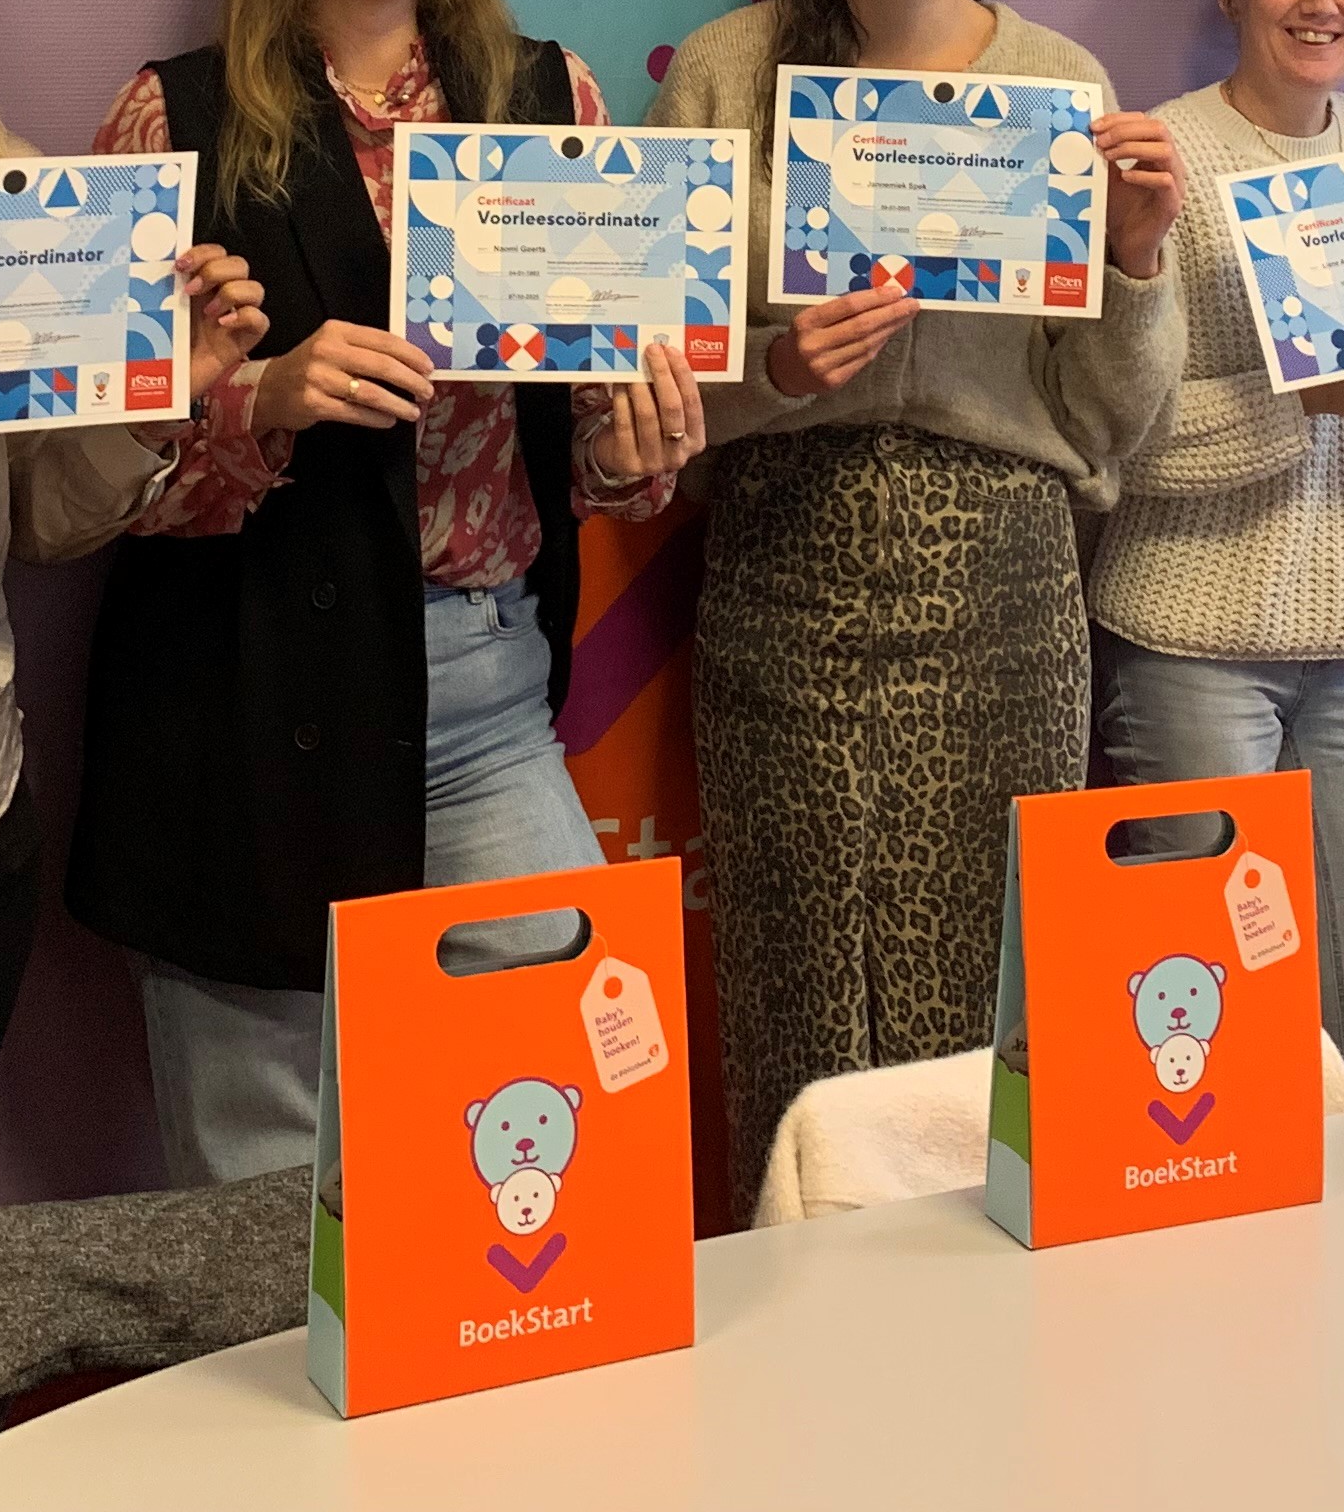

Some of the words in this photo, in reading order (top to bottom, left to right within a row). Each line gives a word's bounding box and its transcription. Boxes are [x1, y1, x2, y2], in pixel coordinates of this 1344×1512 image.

[853, 134, 908, 147] Certificaat
[853, 147, 1025, 170] Voorleescoördinator
[477, 195, 536, 207] Certificaat
[477, 210, 660, 229] Voorleescoördinator
[1297, 216, 1344, 233] Certificaat
[594, 1006, 624, 1026] Baby's
[598, 1015, 634, 1037] houden
[601, 1035, 618, 1048] van
[603, 1034, 641, 1060] boeken!
[1124, 1149, 1239, 1191] BoekStart
[458, 1295, 594, 1348] BoekStart
